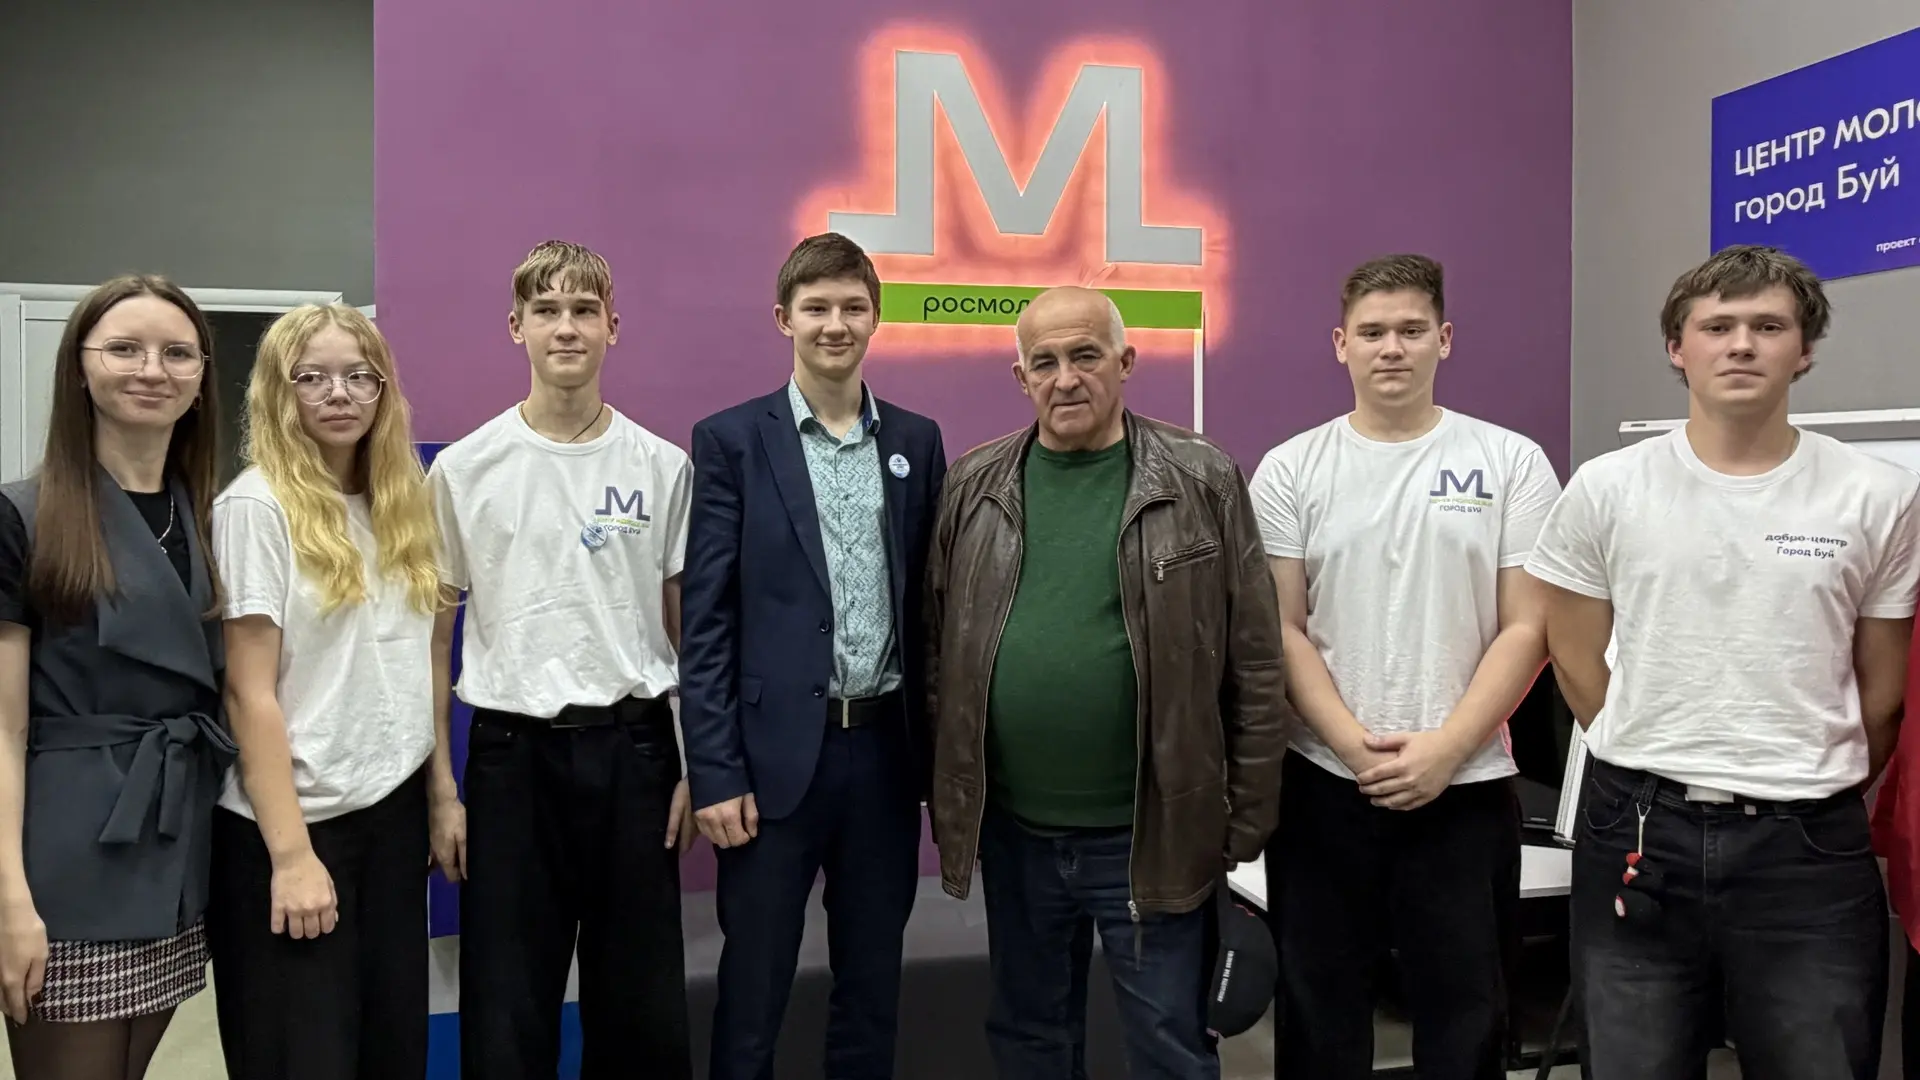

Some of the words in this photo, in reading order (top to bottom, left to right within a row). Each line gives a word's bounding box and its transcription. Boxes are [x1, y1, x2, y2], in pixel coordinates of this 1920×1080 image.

[1734, 126, 1826, 177] ЦЕНТР
[1833, 98, 1920, 149] МОЛ
[1734, 182, 1826, 224] город
[1837, 156, 1900, 203] Буй
[1876, 237, 1917, 254] проект
[923, 296, 1031, 321] росмол
[1765, 534, 1847, 547] добро-центр
[1776, 546, 1811, 557] Город
[1814, 547, 1835, 559] Буй
